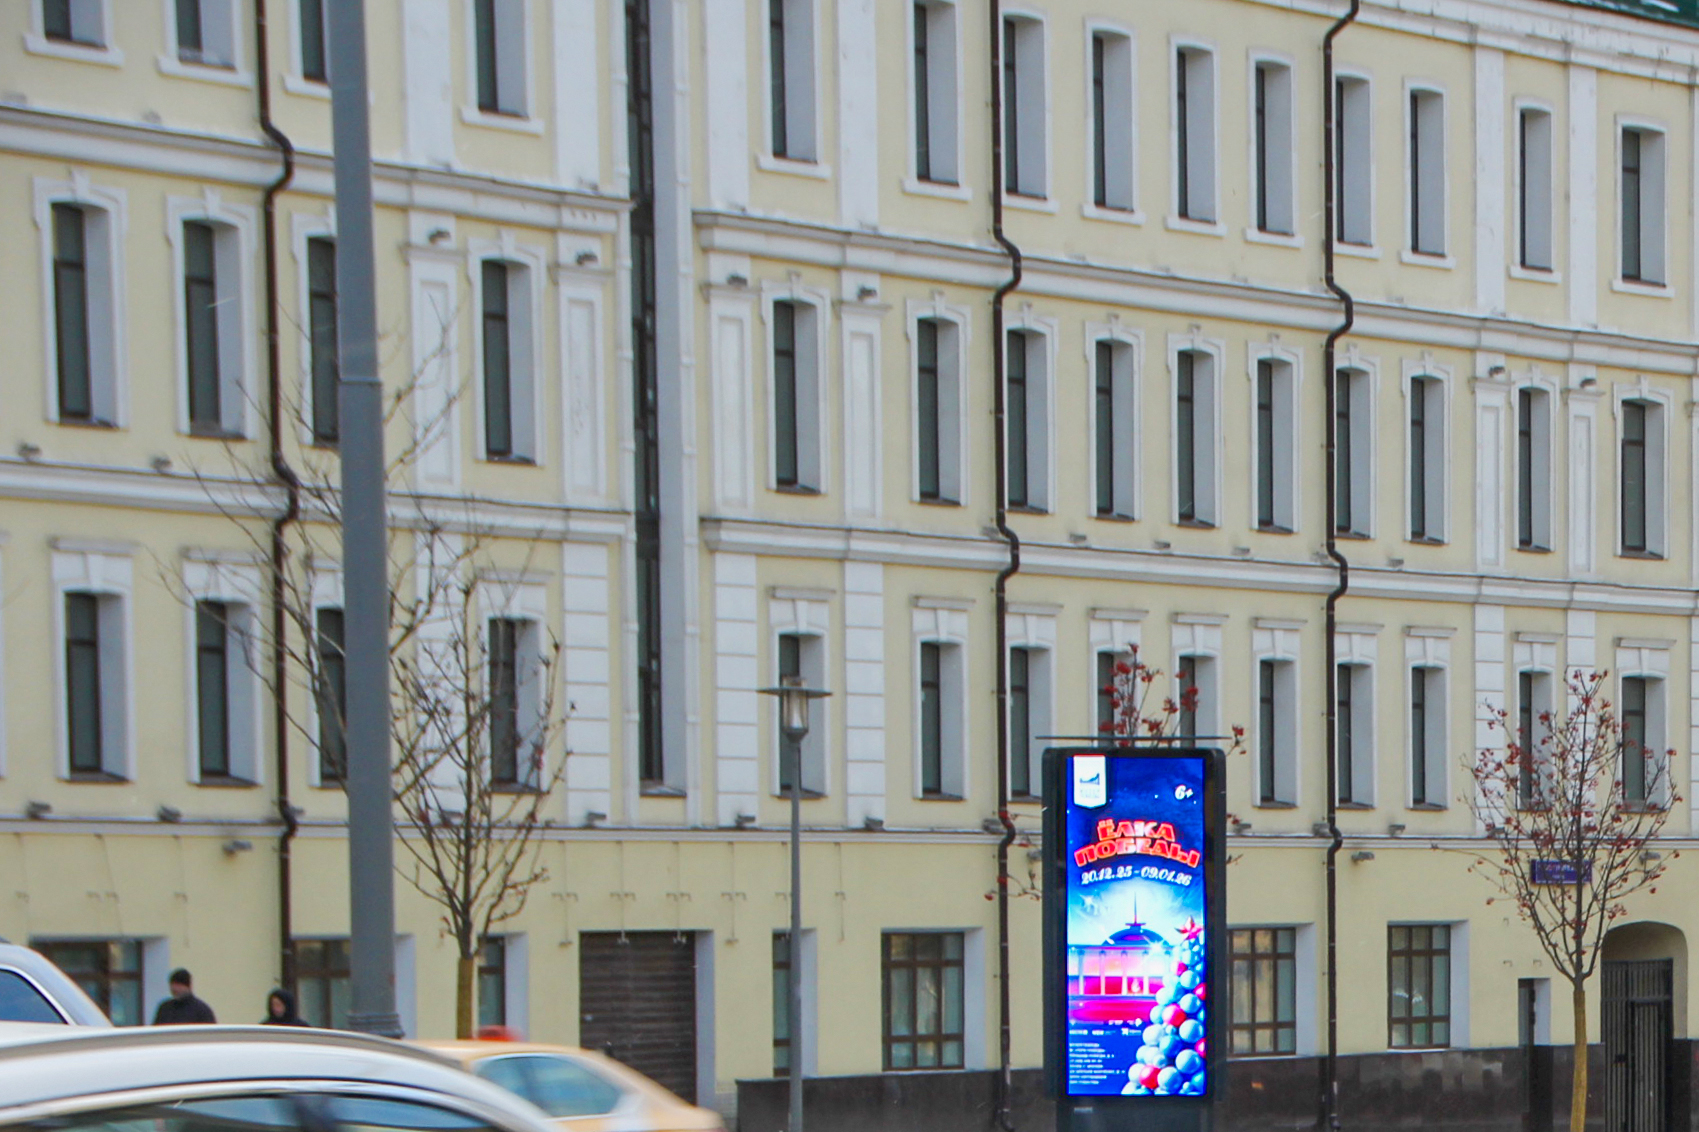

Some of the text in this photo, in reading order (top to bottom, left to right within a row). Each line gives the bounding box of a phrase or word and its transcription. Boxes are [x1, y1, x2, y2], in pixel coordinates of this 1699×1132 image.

[1175, 785, 1194, 801] 6+
[1097, 818, 1176, 842] ЁЛКА
[1074, 838, 1200, 868] ПОБЕДЫ
[1081, 865, 1133, 886] 20.12.25
[1141, 866, 1193, 887] 09.01.26
